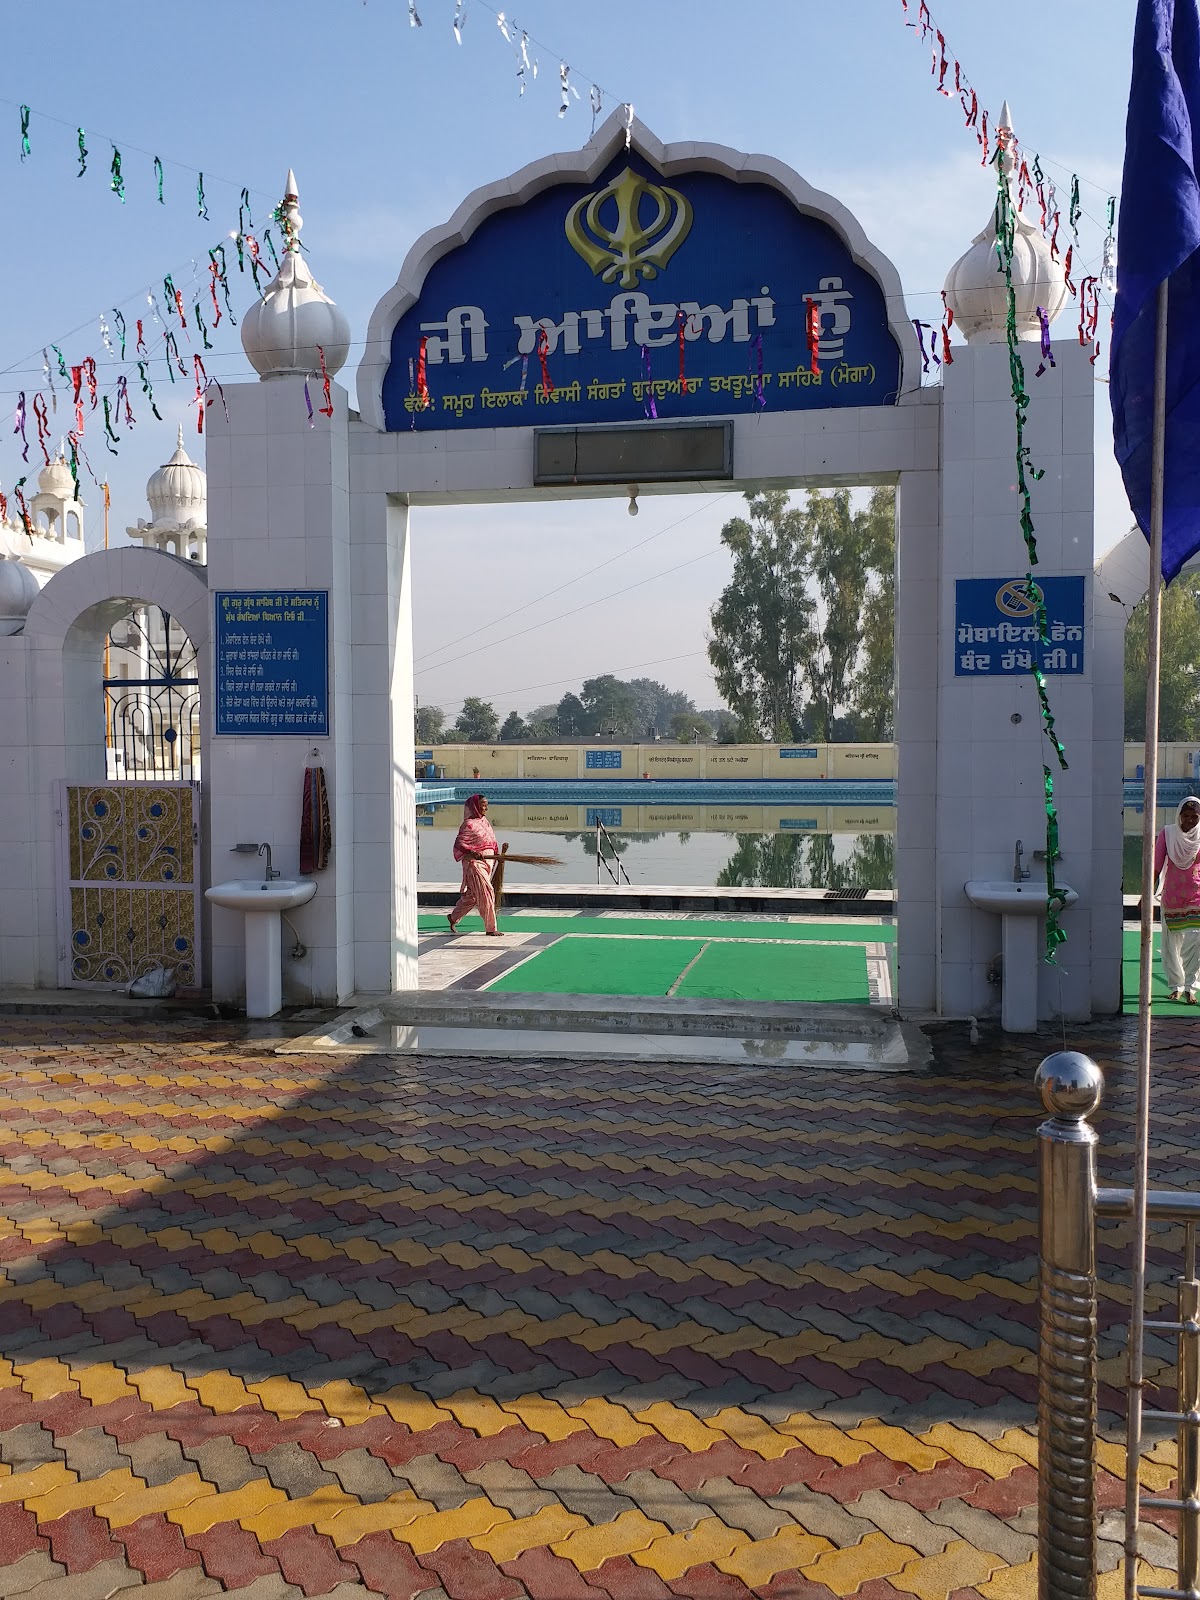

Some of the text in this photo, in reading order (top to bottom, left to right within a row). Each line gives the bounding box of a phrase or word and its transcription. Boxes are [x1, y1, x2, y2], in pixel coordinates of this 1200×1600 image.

[419, 276, 853, 364] ਜੀ ਆਇਆਂ ਨੂੰ
[442, 394, 475, 417] ਸਮੂਹ
[480, 387, 528, 408] ਇਲਾਕਾ
[534, 380, 581, 404] ਨਿਵਾਸੀ
[587, 378, 626, 400] ਸੰਗਤਾਂ
[778, 364, 823, 388] ਸਾਹਿਬ
[830, 360, 876, 388] (ਮੋਗਾ)
[257, 597, 273, 607] ਸਾਹਿਬ
[275, 597, 282, 606] ਜੀ
[284, 595, 289, 607] ਦੇ
[262, 611, 282, 621] ਧਿਆਨ
[958, 620, 1082, 643] ਮੋਬਾਇਲ ਫੋਨ
[960, 650, 990, 671] ਬੰਦ
[1001, 649, 1032, 670] ਰੱਖੋ
